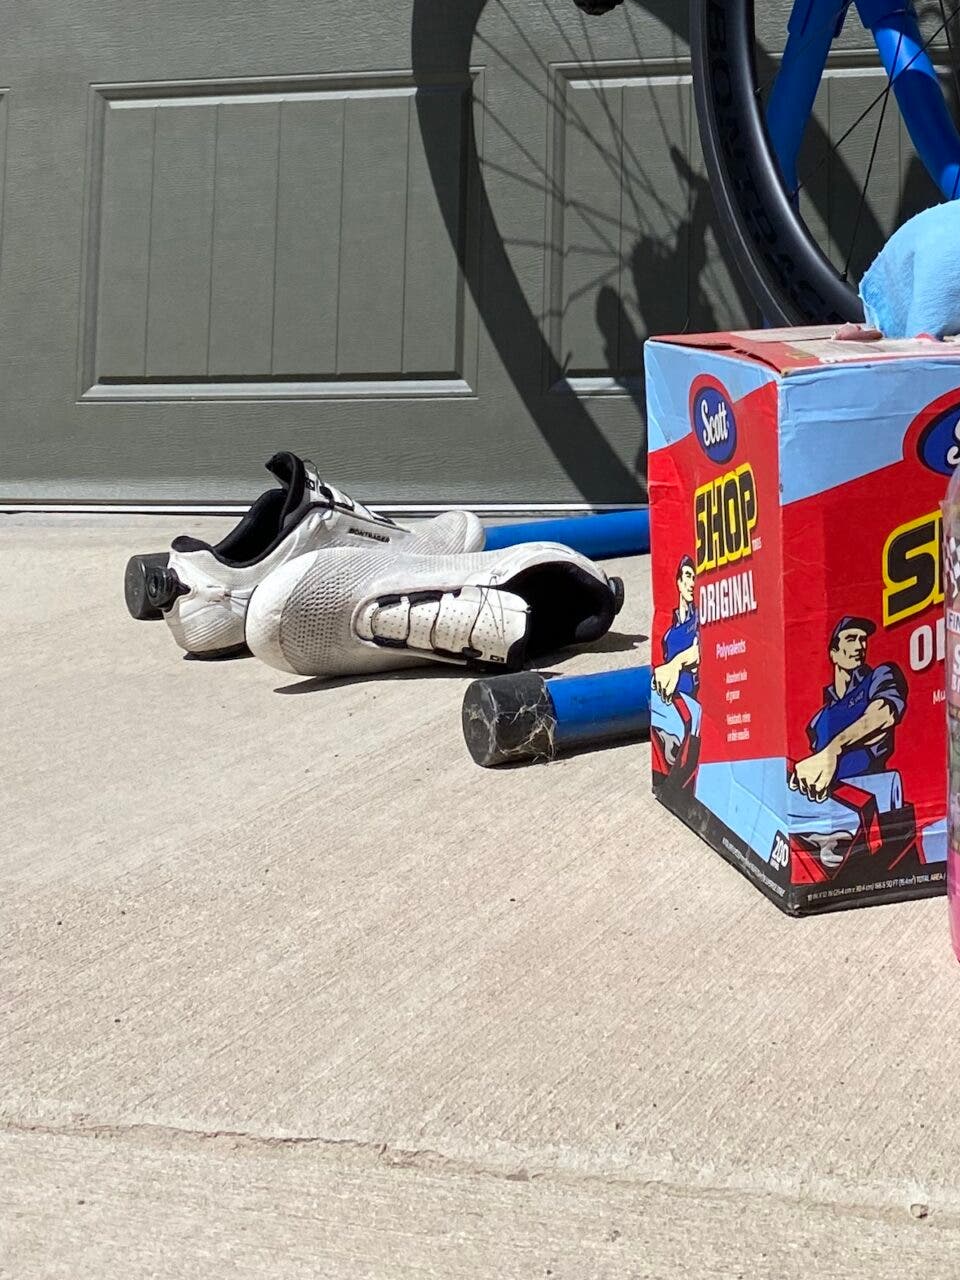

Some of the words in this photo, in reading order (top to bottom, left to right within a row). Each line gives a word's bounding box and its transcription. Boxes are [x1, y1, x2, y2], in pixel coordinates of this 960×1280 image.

[701, 399, 728, 447] Scott
[695, 464, 758, 573] SHOP
[700, 572, 757, 625] ORIGINAL
[773, 834, 789, 868] 200
